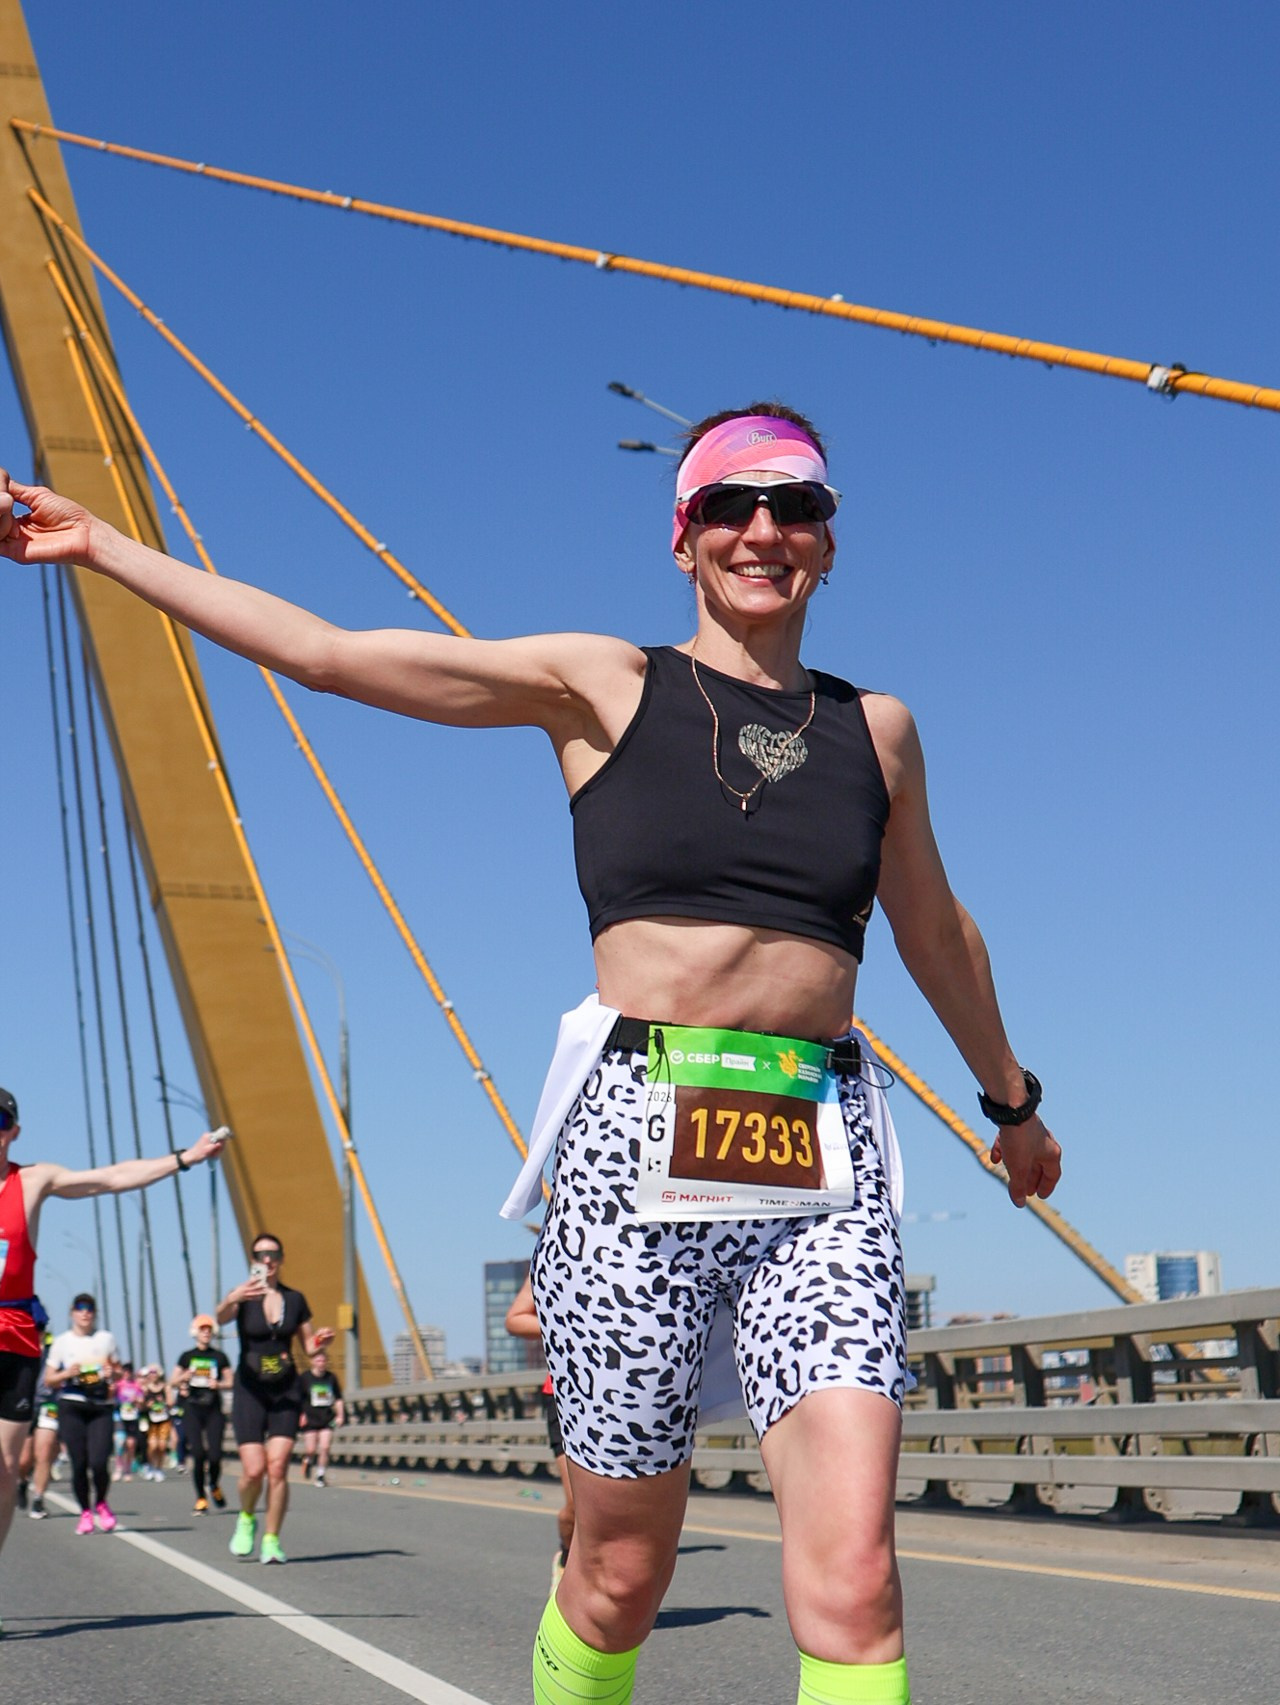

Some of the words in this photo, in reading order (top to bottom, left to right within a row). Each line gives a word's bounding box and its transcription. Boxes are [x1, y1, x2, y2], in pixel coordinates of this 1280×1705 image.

[686, 1052, 721, 1065] СБЕР
[647, 1114, 666, 1142] G
[690, 1107, 814, 1168] 17333
[679, 1194, 734, 1203] МАГНИТ
